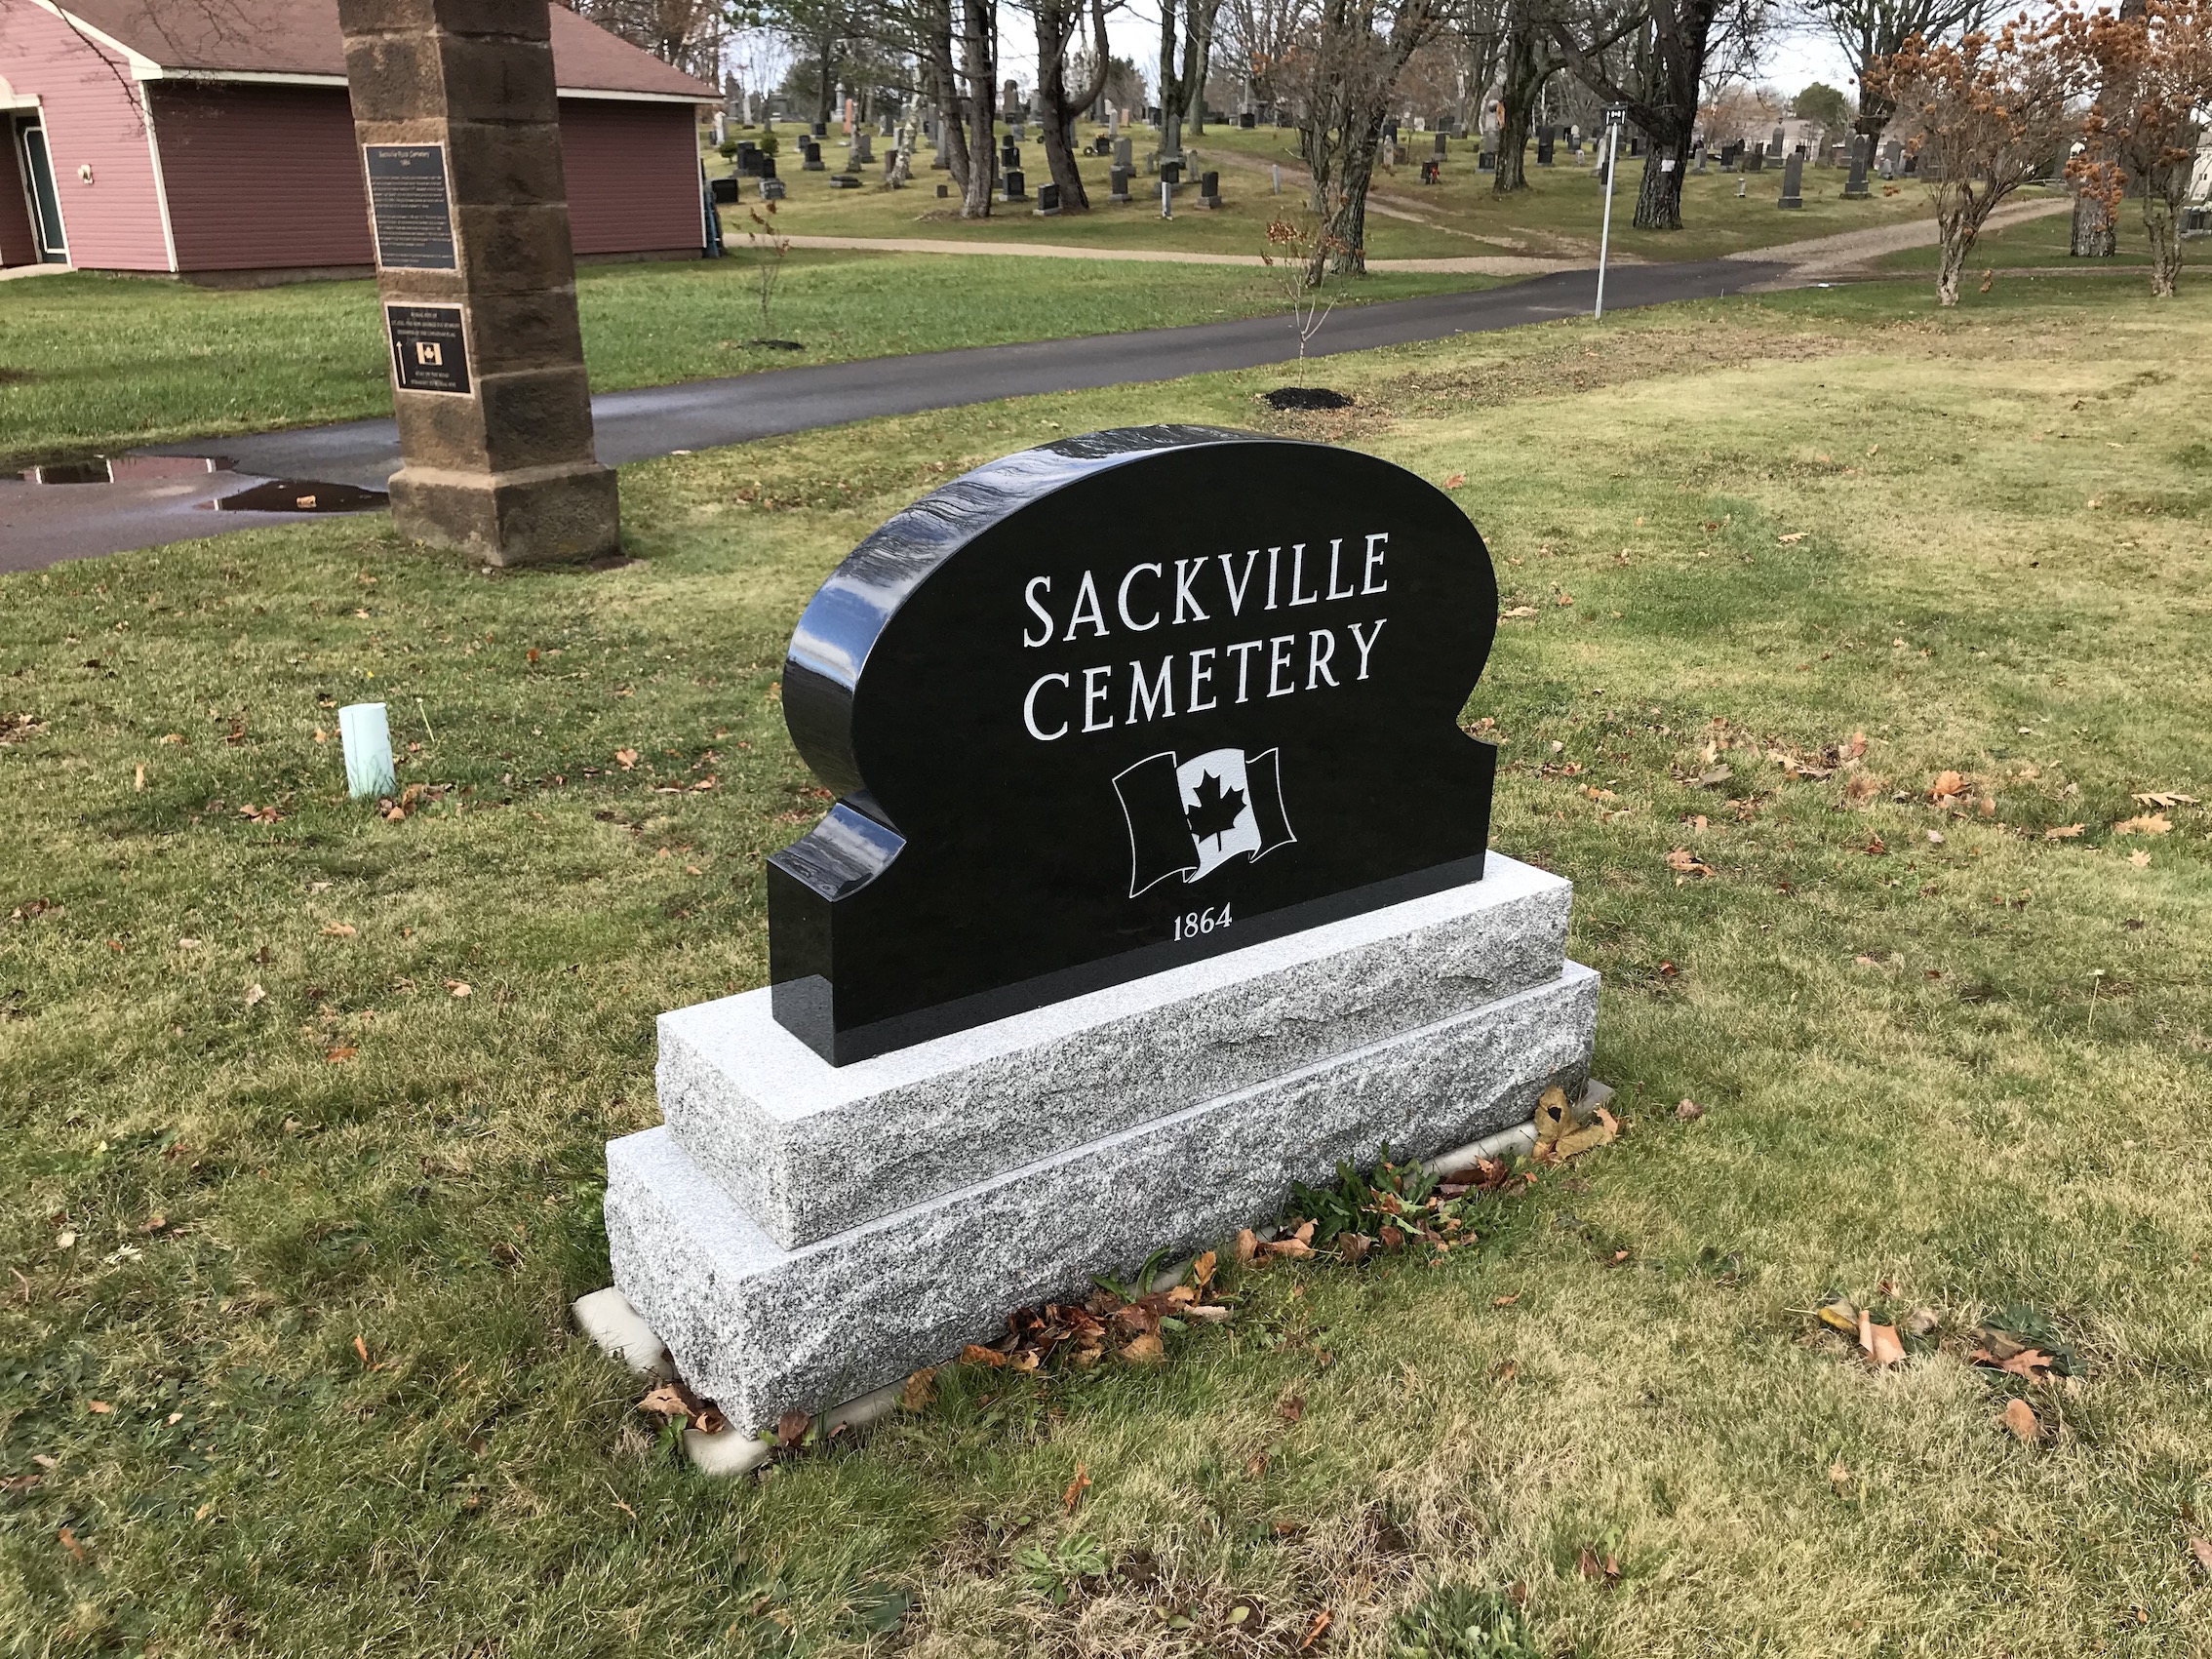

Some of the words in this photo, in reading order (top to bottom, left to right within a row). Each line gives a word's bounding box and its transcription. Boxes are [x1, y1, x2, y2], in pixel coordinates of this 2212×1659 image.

[1023, 532, 1389, 649] SACKVILLE
[1023, 617, 1388, 741] CEMETERY
[1173, 901, 1233, 942] 1864
